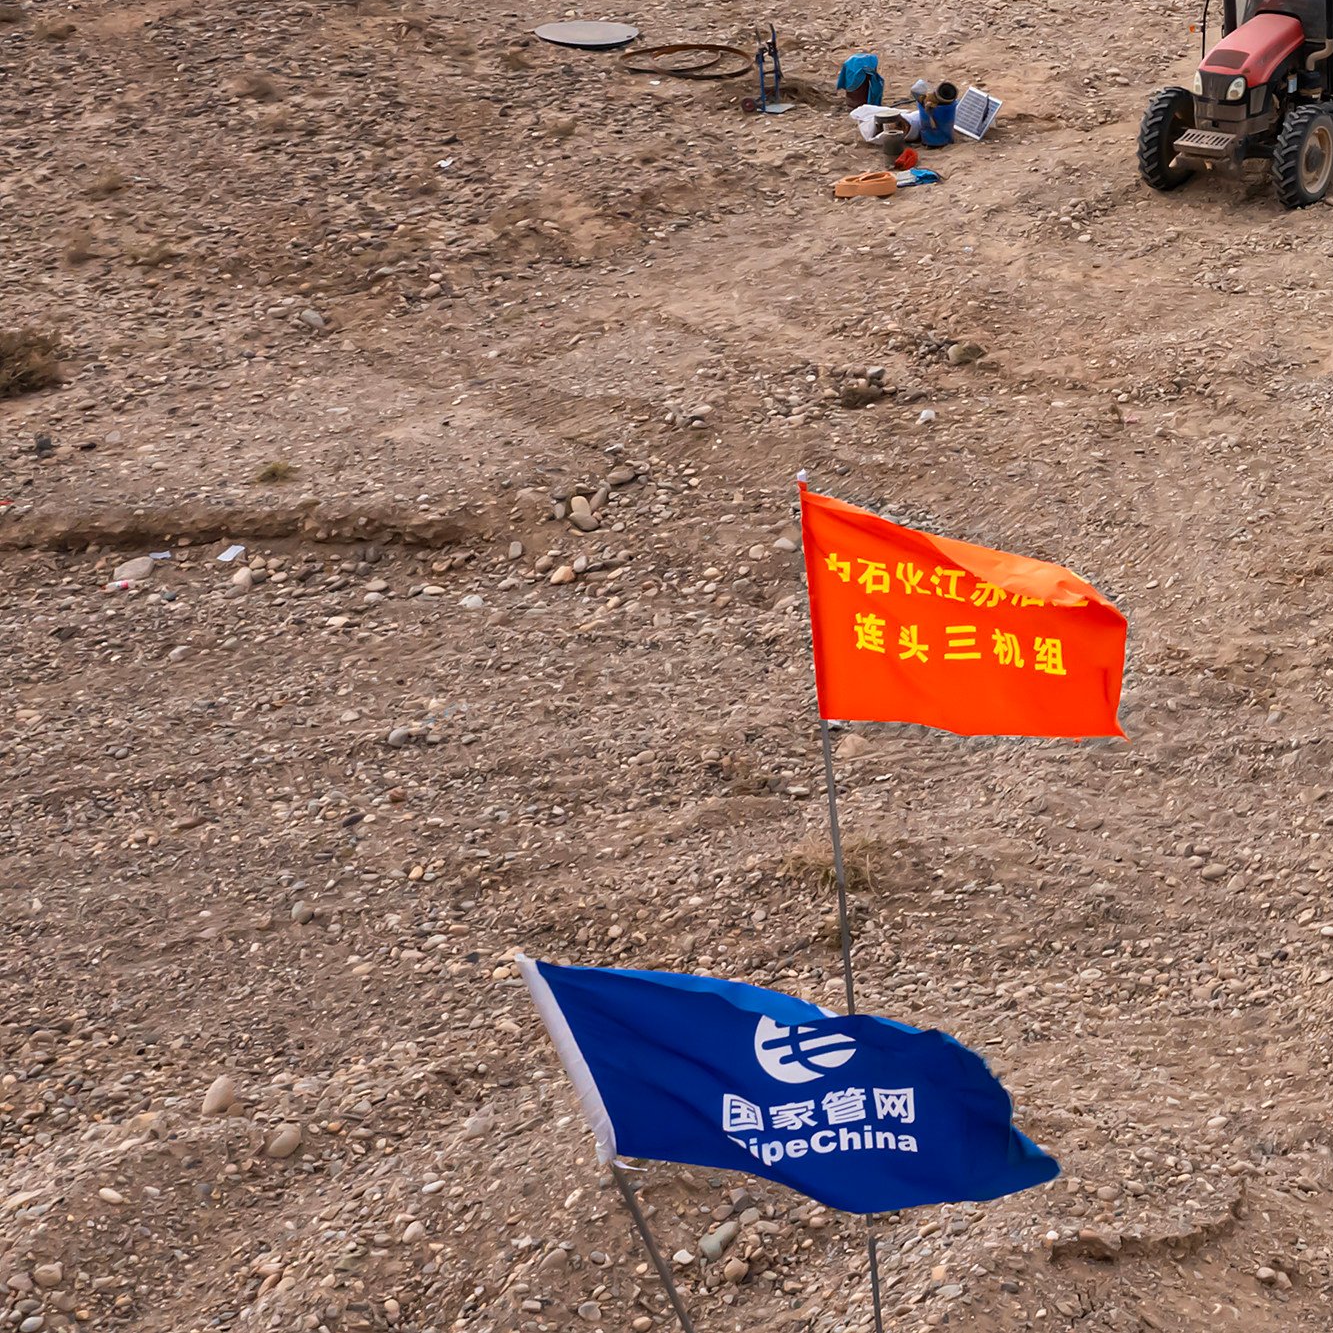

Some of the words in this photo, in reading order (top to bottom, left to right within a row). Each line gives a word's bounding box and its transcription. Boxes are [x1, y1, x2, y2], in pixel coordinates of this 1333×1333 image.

[824, 552, 1090, 608] 中石化江苏
[854, 613, 1067, 676] 连头三机组
[722, 1087, 916, 1132] 国家管网
